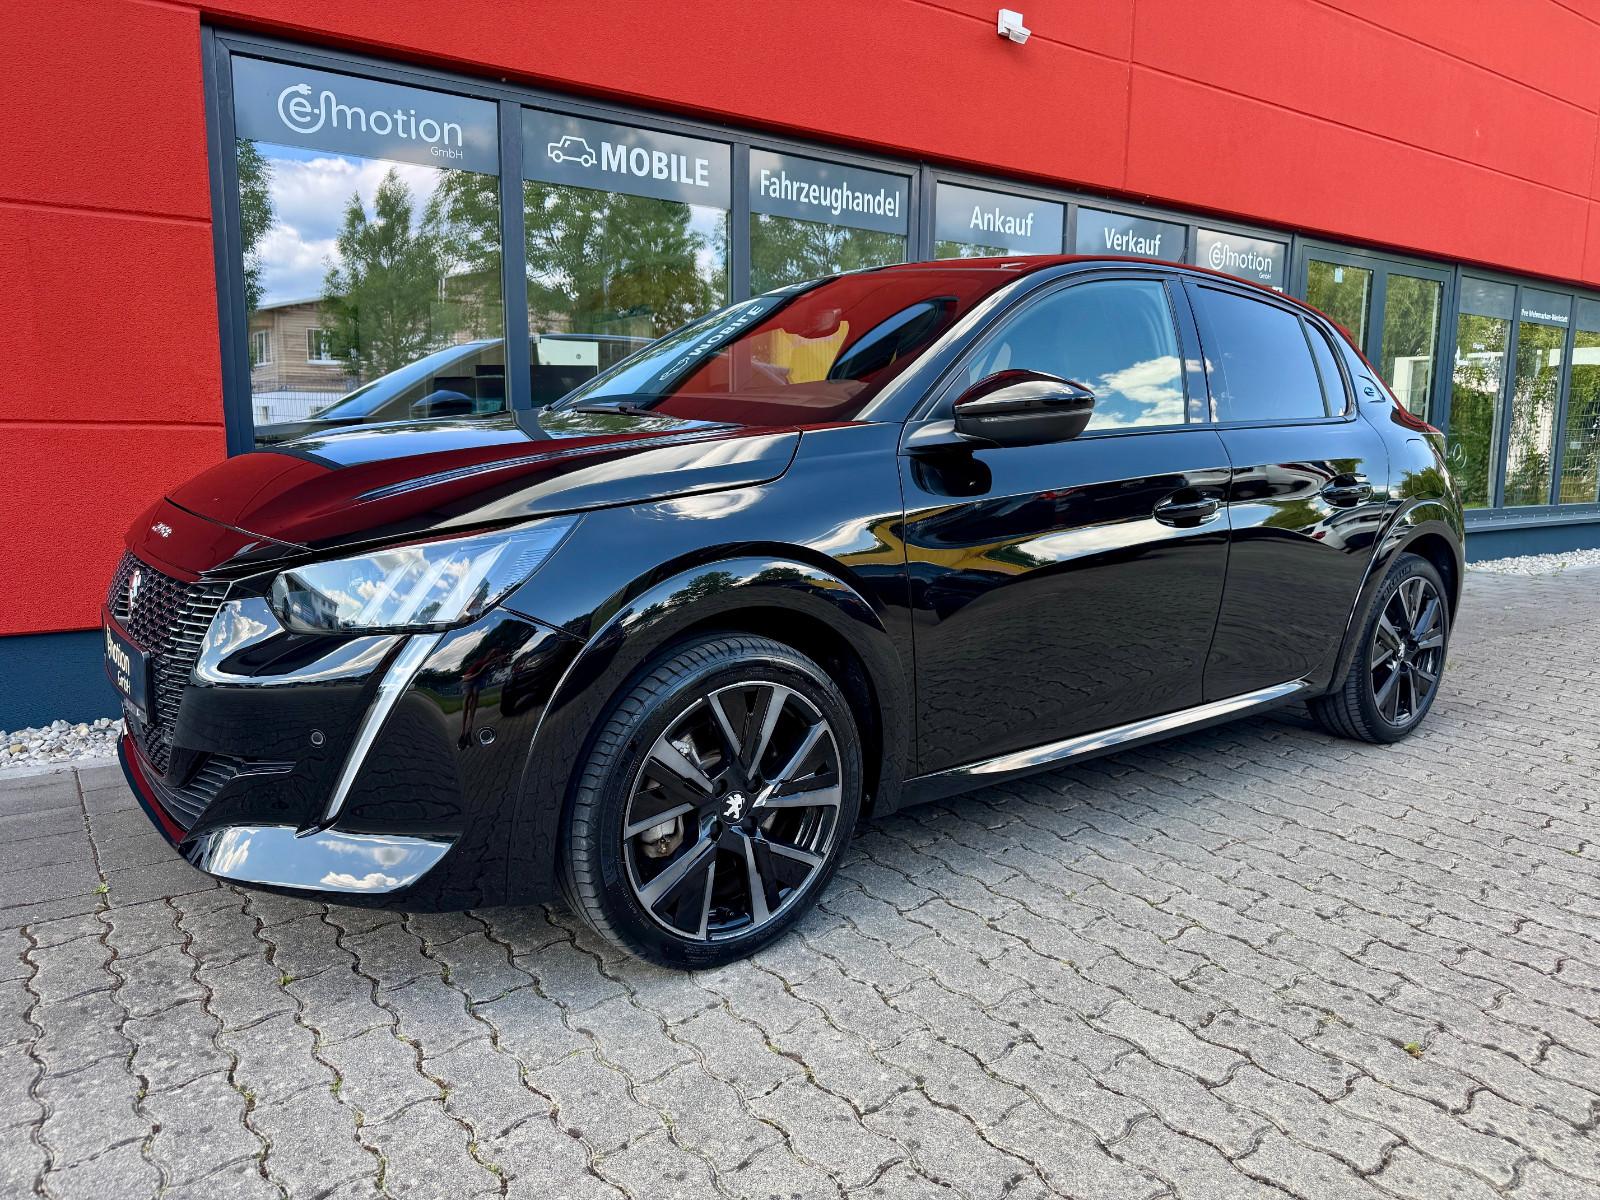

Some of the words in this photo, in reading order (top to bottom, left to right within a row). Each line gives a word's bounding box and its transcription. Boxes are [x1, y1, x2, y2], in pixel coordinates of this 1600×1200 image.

[430, 146, 463, 160] GmbH
[601, 141, 709, 187] MOBILE
[760, 169, 900, 218] Fahrzeughandel
[969, 206, 1034, 237] Ankauf
[1104, 227, 1161, 256] Verkauf
[1258, 272, 1272, 280] GmbH
